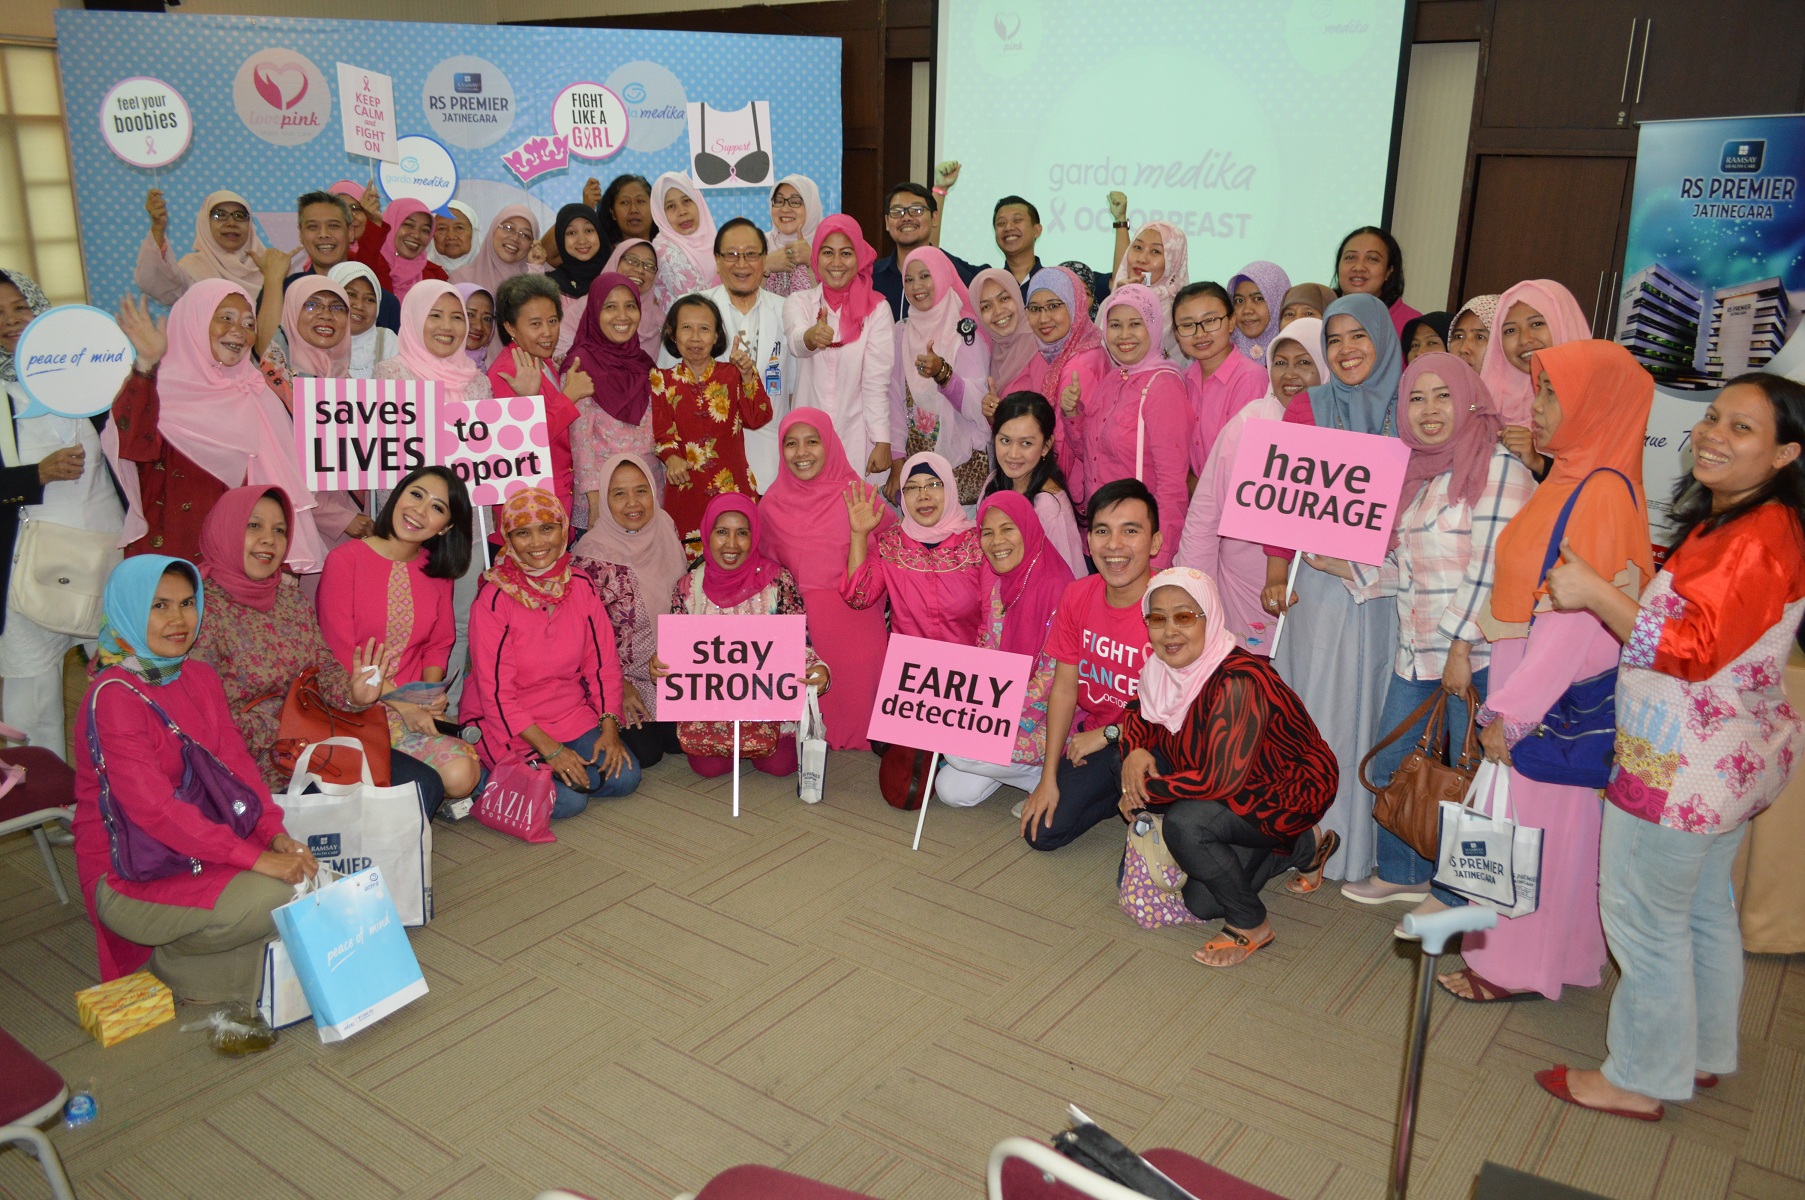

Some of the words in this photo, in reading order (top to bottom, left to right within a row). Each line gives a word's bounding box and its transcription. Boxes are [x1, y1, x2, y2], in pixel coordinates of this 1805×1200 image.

[117, 96, 139, 110] feel
[141, 95, 166, 110] your
[355, 92, 380, 107] KEEP
[429, 96, 446, 110] RS
[450, 96, 509, 111] PREMIER
[572, 93, 604, 108] FIGHT
[354, 105, 384, 121] CALM
[442, 113, 498, 123] JATINEGARA
[572, 109, 597, 125] LIKE
[599, 110, 607, 125] A
[640, 105, 685, 119] medika
[114, 110, 178, 133] boobies
[364, 119, 376, 127] and
[355, 126, 385, 141] FIGHT
[364, 140, 380, 153] ON
[711, 139, 751, 155] Support
[1049, 156, 1127, 192] garda
[1132, 148, 1257, 191] medika
[413, 176, 450, 188] medika
[1680, 178, 1704, 198] RS
[1708, 178, 1796, 200] PREMIER
[1692, 204, 1773, 219] JATINEGARA
[26, 354, 67, 371] peace
[70, 347, 87, 366] of
[90, 347, 125, 363] mind
[315, 400, 416, 425] saves
[454, 418, 489, 443] to
[314, 437, 425, 472] LIVES
[1263, 444, 1371, 494] have
[1236, 480, 1387, 531] COURAGE
[692, 635, 774, 671] stay
[1083, 628, 1139, 667] FIGHT
[665, 673, 798, 701] STRONG
[898, 661, 1014, 709] EARLY
[881, 693, 1011, 738] detection
[311, 844, 338, 852] RAMSAY
[1459, 857, 1504, 876] PREMIER
[1454, 869, 1496, 885] JATINEGARA
[327, 938, 354, 967] peace
[356, 926, 364, 944] of
[369, 910, 391, 936] mind
